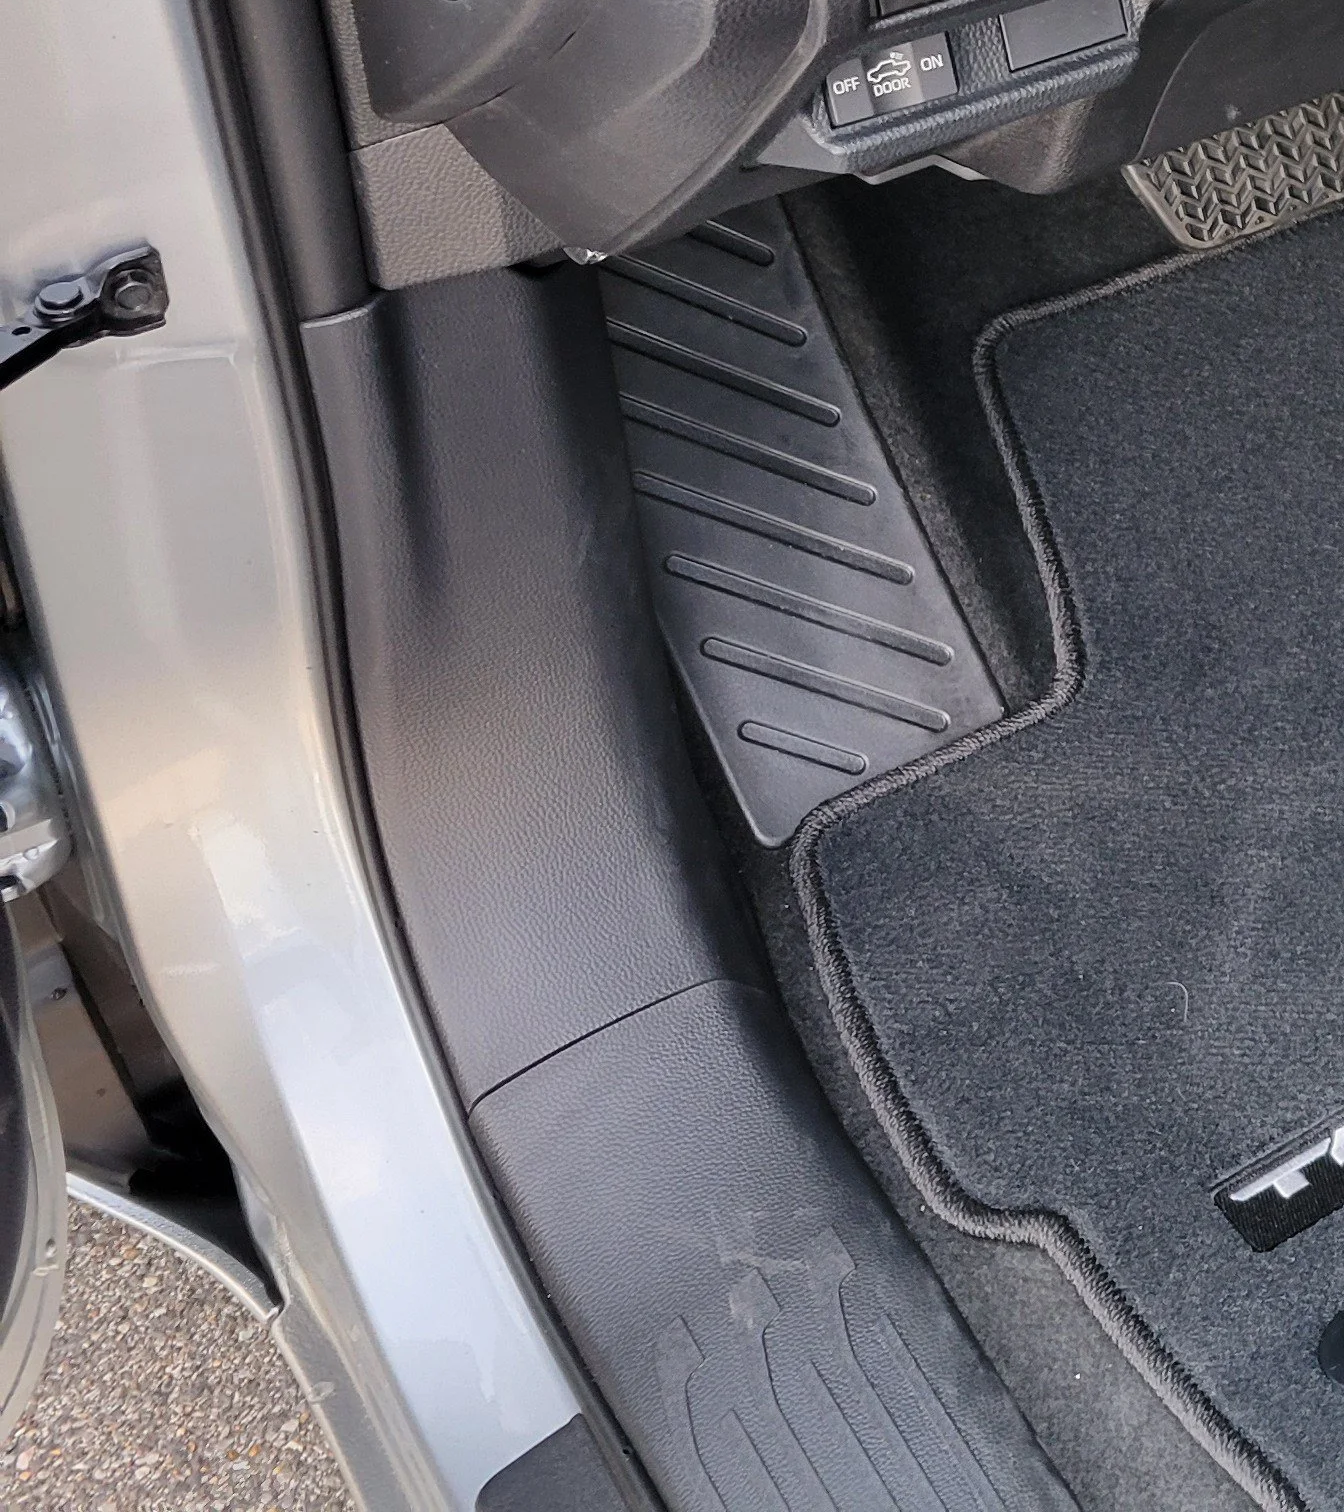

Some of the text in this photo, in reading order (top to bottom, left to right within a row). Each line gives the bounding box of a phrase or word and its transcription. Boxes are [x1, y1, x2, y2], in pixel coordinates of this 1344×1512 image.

[920, 53, 945, 71] ON
[832, 76, 861, 95] OFF
[873, 77, 911, 97] DOOR
